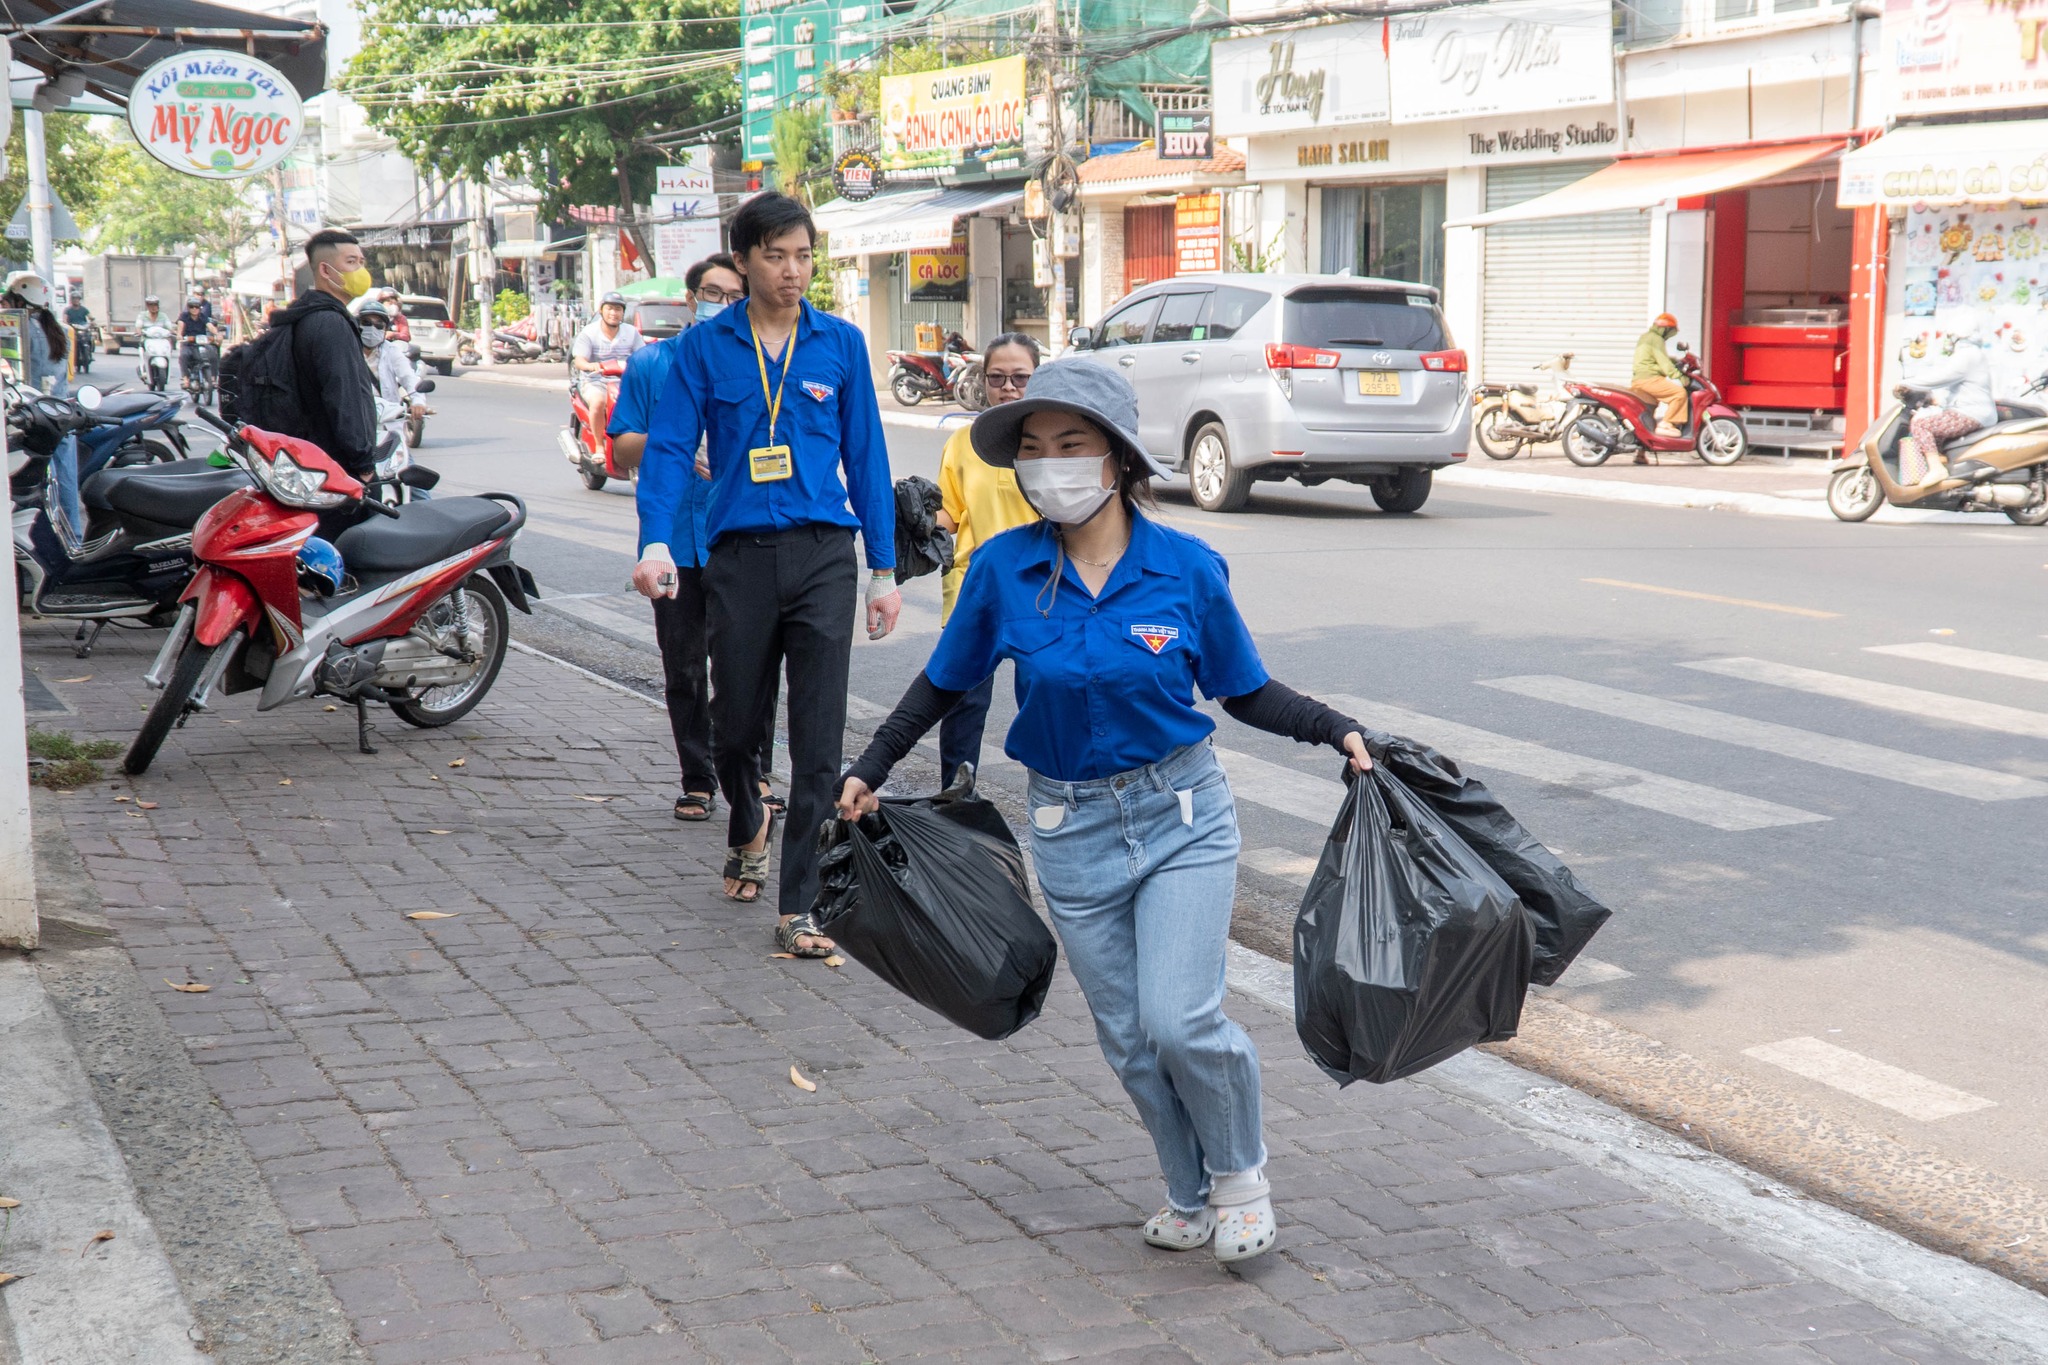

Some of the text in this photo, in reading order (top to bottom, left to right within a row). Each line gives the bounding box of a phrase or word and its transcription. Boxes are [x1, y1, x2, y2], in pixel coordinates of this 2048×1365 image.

[1394, 19, 1426, 41] Bridal
[145, 58, 284, 100] Xôi Miền Tây
[150, 104, 291, 157] Mỹ Ngọc
[940, 109, 971, 147] CANH
[1468, 121, 1618, 154] The Wedding Studio
[1164, 132, 1209, 156] HUY
[1297, 139, 1390, 167] HAIR SALON
[661, 178, 709, 189] HANI
[1883, 164, 1957, 197] CHÂN
[918, 260, 933, 279] CÁ
[149, 557, 185, 570] SUZUKI
